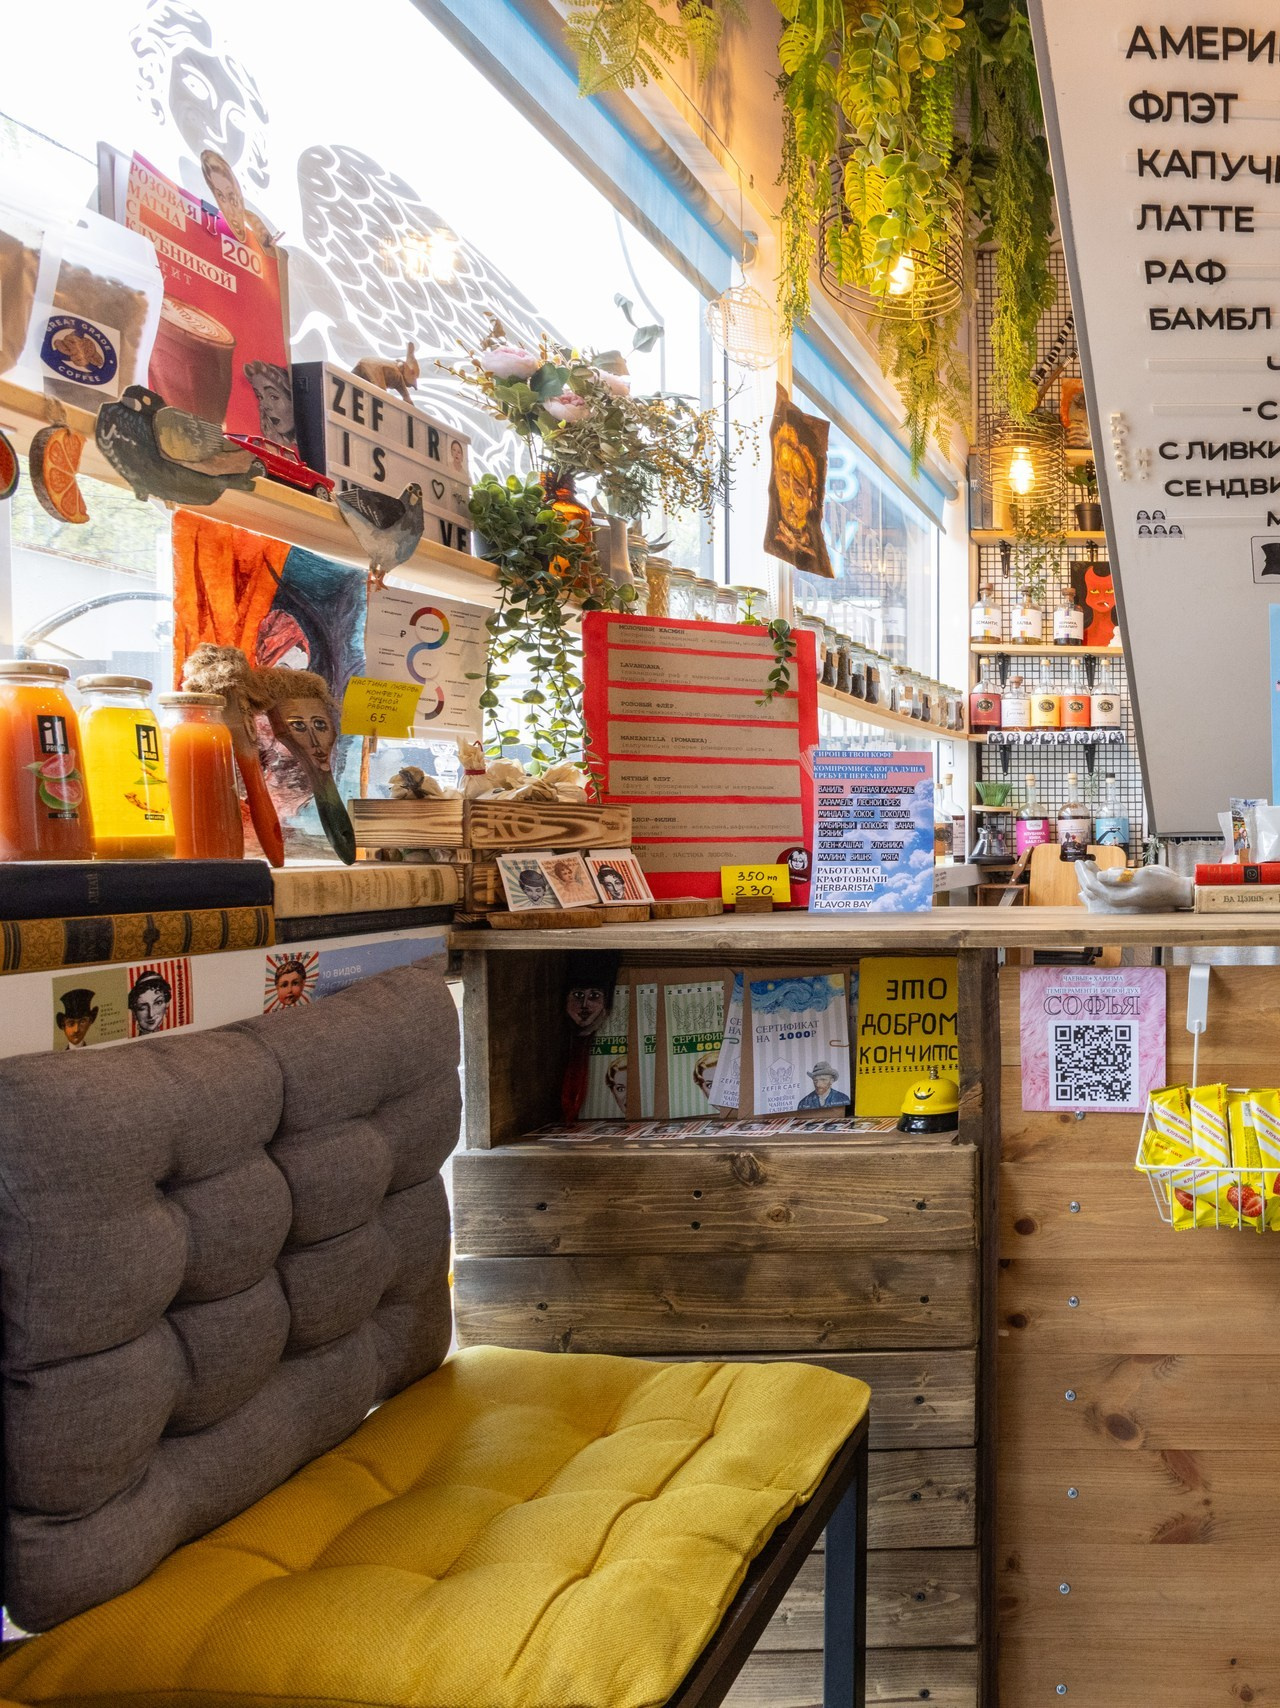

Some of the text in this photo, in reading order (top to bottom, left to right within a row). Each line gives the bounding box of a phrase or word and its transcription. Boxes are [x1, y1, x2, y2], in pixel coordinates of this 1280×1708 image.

[1128, 90, 1239, 124] ФЛЭТ
[130, 162, 197, 221] РОЗОВАЯ
[126, 199, 137, 215] С
[128, 181, 182, 228] МАТЧА
[1137, 205, 1255, 233] ЛАТТЕ
[223, 239, 262, 275] 200
[1145, 258, 1227, 286] РАФ
[1149, 307, 1272, 332] БАМБЛ
[47, 319, 112, 352] GREAT GRADE
[58, 365, 100, 382] COFFEE
[332, 376, 440, 462] ZEFIR
[343, 431, 386, 482] IS
[366, 689, 403, 698] КОНФЕТЫ
[369, 696, 399, 705] РУЧНОЙ
[367, 703, 398, 712] РАБОТЫ
[738, 871, 764, 882] 350
[853, 900, 871, 908] BAY
[1223, 895, 1235, 903] БА
[1237, 894, 1264, 903] ЦЗИНЬ
[322, 965, 362, 979] 10 ВИДОВ
[886, 977, 947, 1001] ЭТО
[1044, 995, 1140, 1016] СОФЬЯ
[756, 1020, 819, 1034] СЕРТИФИКАТ
[861, 1012, 958, 1036] ДОБРОМ
[696, 1042, 721, 1051] 500
[756, 1035, 770, 1043] НА
